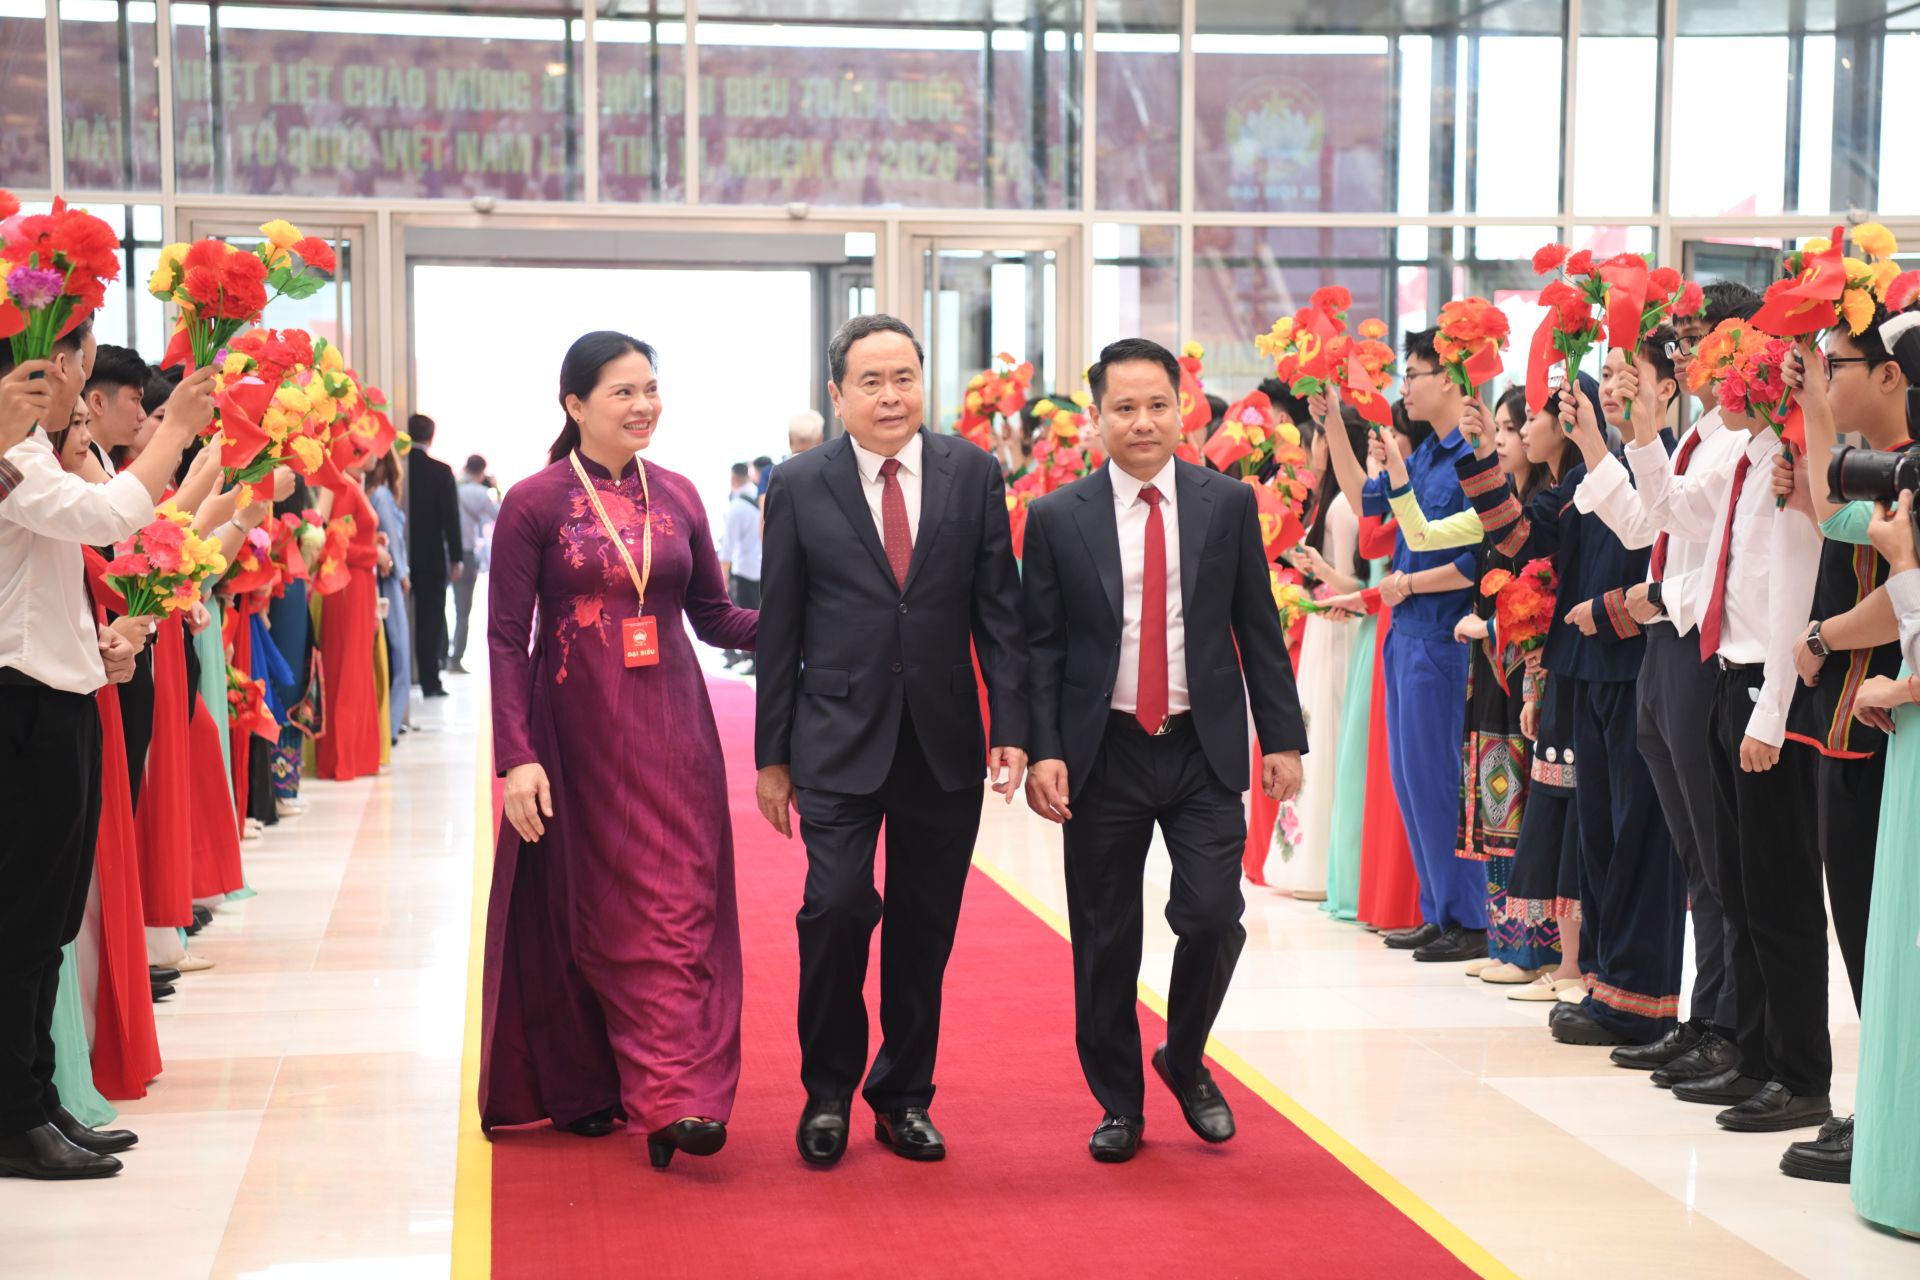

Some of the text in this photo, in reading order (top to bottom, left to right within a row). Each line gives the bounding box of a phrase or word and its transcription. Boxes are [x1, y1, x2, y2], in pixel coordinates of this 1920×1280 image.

[175, 56, 257, 110] NHỆT
[270, 57, 333, 112] LIỆT
[342, 58, 427, 109] CHÀO
[435, 61, 532, 112] MỪNG
[663, 75, 715, 117] ĐI
[724, 65, 790, 118] BIỂU
[886, 70, 964, 126] QUỐC
[237, 111, 278, 167] TỔ
[288, 118, 371, 176] QUỐC
[381, 124, 448, 178] VIỆT
[455, 130, 533, 175] NAM
[878, 139, 957, 182] 2026
